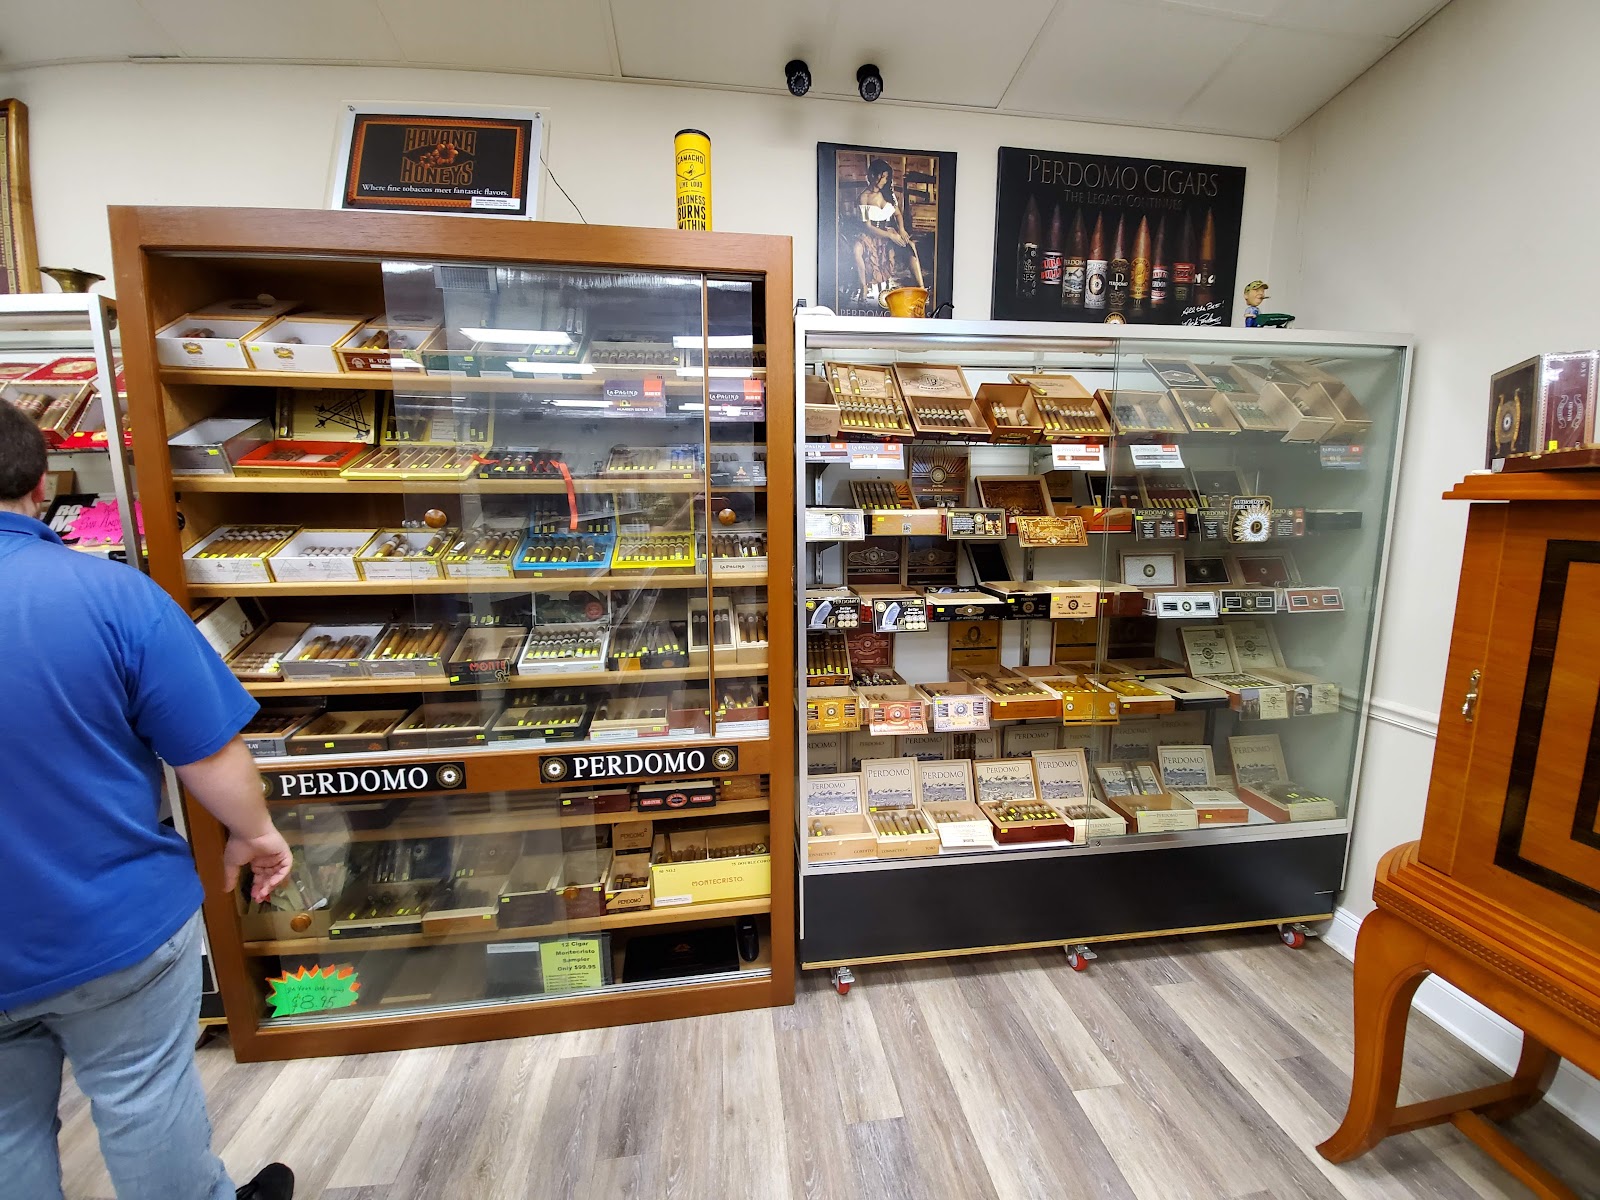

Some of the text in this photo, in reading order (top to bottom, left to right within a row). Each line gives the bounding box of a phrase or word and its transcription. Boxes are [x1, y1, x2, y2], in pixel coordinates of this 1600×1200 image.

[403, 128, 477, 156] HAVANA
[677, 154, 703, 165] CAMACHO
[400, 157, 474, 186] HONEYS
[1027, 154, 1219, 197] PERDOMO CIGARS
[362, 183, 509, 196] Where fine tobaccos meet fantastic flavors.
[677, 195, 705, 206] BOLDNESS
[678, 205, 706, 220] BURNS
[678, 220, 706, 231] WITHIN
[905, 736, 942, 744] PERDOMO
[1014, 732, 1049, 740] PERDOMO
[573, 750, 706, 778] PERDOMO
[1038, 760, 1078, 769] PERDOMO
[1163, 756, 1204, 764] PERDOMO
[868, 768, 910, 778] PERDOMO
[923, 771, 964, 779] PERDOMO
[986, 766, 1020, 774] PERDOMO
[279, 767, 429, 797] PERDOMO
[812, 782, 846, 790] PERDOMO
[292, 993, 337, 1013] $8.95
